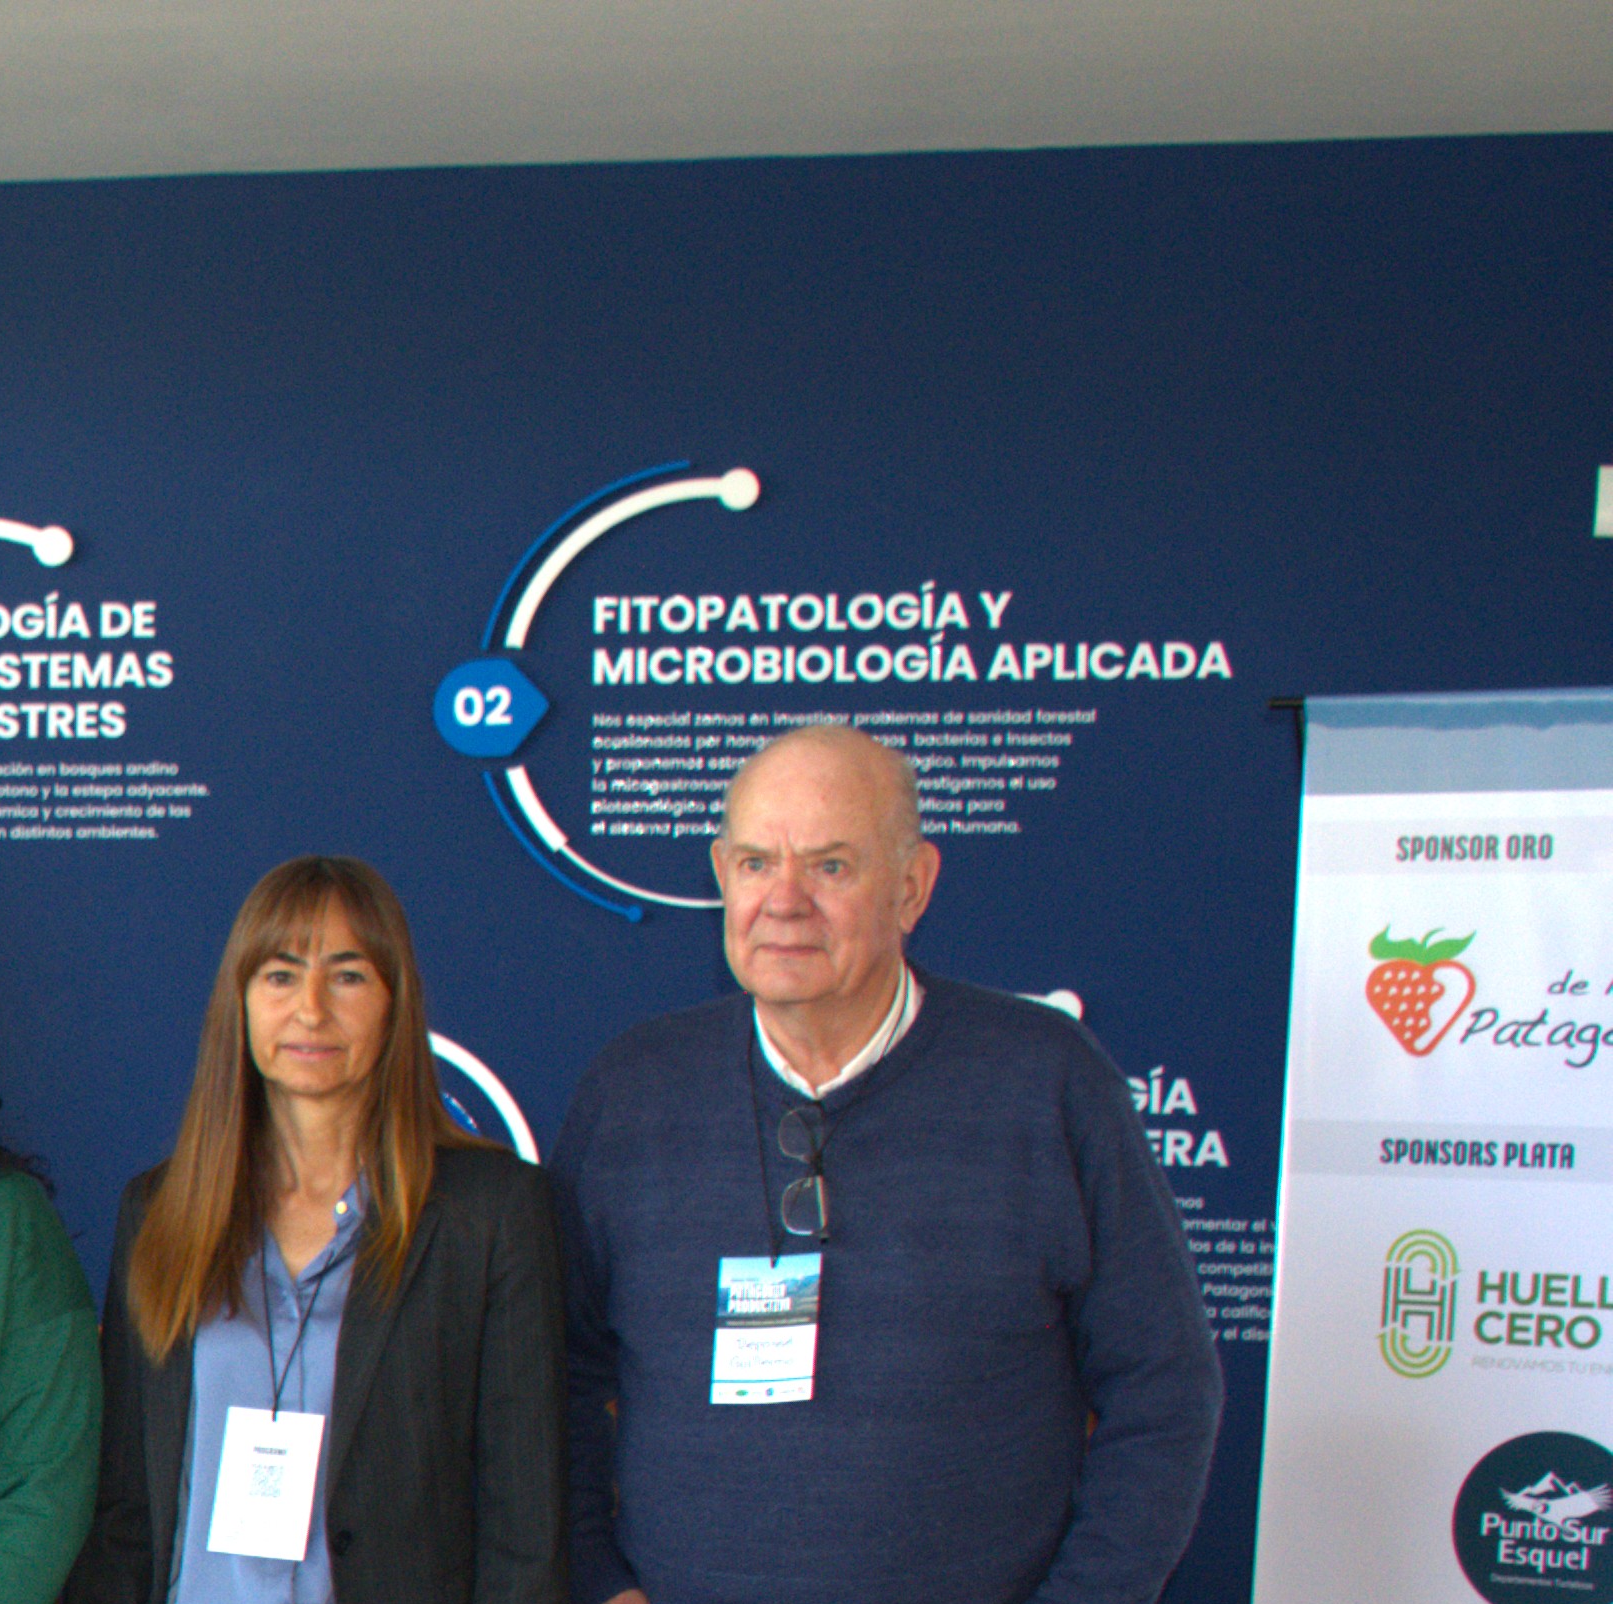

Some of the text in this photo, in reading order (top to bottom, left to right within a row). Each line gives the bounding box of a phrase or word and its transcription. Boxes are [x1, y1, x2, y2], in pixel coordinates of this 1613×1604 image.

[593, 582, 1012, 636] FITOPATOLOGÍA Y
[99, 602, 156, 638] DE
[592, 632, 1232, 684] MICROBIOLOGÍA APLICADA
[453, 686, 513, 726] 02
[749, 713, 769, 725] en
[853, 711, 939, 728] problemas
[943, 711, 964, 724] de
[967, 710, 1032, 724] sanidad
[1035, 709, 1097, 723] forestal
[695, 736, 722, 750] por
[913, 732, 989, 746] bacterias
[1005, 732, 1072, 745] insectos
[36, 765, 56, 776] en
[59, 763, 122, 778] bosques
[126, 762, 179, 775] andino
[591, 758, 603, 775] y
[605, 757, 705, 772] proponemos
[591, 779, 607, 792] la
[1009, 777, 1024, 788] el
[1027, 778, 1057, 789] uso
[42, 786, 51, 801] y
[54, 784, 69, 796] la
[72, 785, 123, 799] estepa
[41, 807, 51, 822] y
[54, 805, 143, 817] crecimiento
[145, 805, 165, 817] de
[169, 805, 191, 817] las
[966, 800, 1005, 814] para
[9, 825, 72, 838] distintos
[591, 821, 606, 834] el
[1396, 834, 1554, 861] SPONSOR ORO
[1547, 969, 1590, 995] de
[1379, 1138, 1576, 1169] SPONSORS PLATA
[1473, 1311, 1602, 1349] CERO
[1481, 1510, 1610, 1544] Punto Sur
[1498, 1537, 1592, 1573] Esquel
